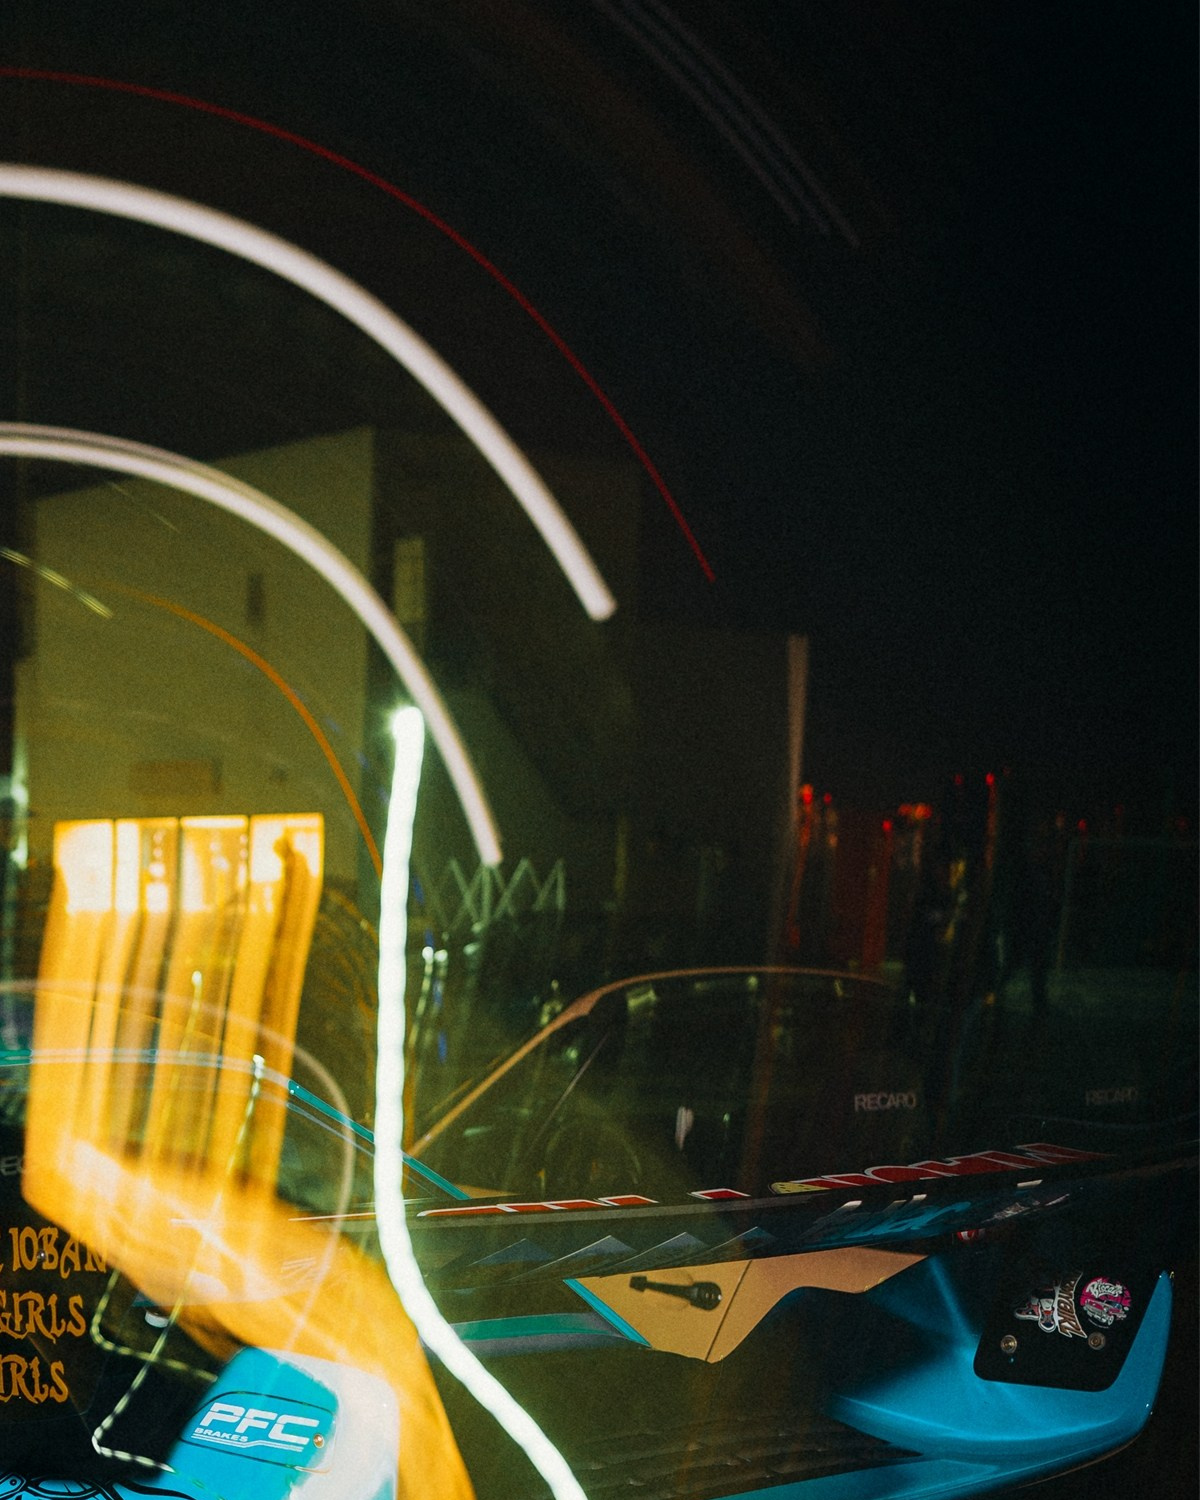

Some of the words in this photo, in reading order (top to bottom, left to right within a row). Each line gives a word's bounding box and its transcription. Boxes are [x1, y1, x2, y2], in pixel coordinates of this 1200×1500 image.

[854, 1091, 916, 1112] RECARO
[200, 1402, 320, 1445] PFC
[194, 1427, 249, 1443] BRAKES
